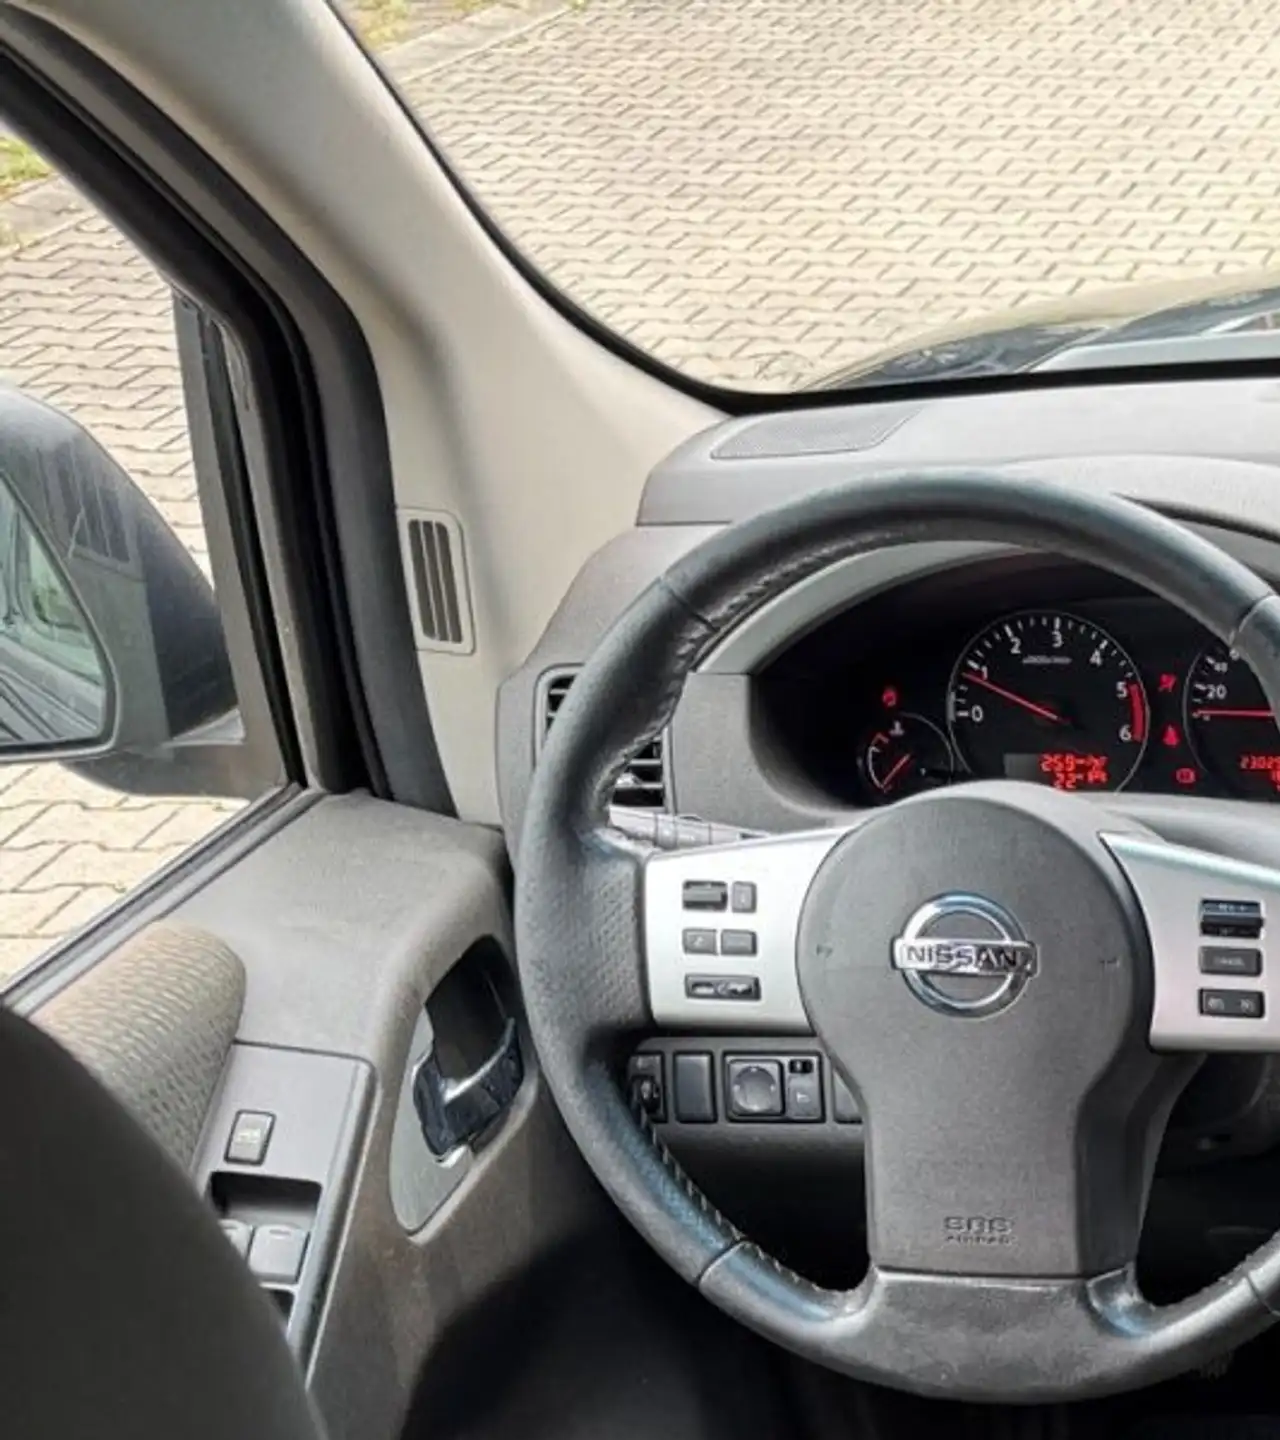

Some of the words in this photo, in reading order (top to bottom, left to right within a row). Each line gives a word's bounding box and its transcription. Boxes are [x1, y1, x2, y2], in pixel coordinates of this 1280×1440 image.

[1010, 638, 1021, 654] 2
[1052, 632, 1063, 647] 3
[1089, 650, 1102, 666] 4
[1116, 682, 1127, 699] 5
[1207, 684, 1227, 699] 20
[972, 706, 983, 721] 0
[1119, 725, 1131, 741] 6
[907, 945, 1017, 967] NISSAN
